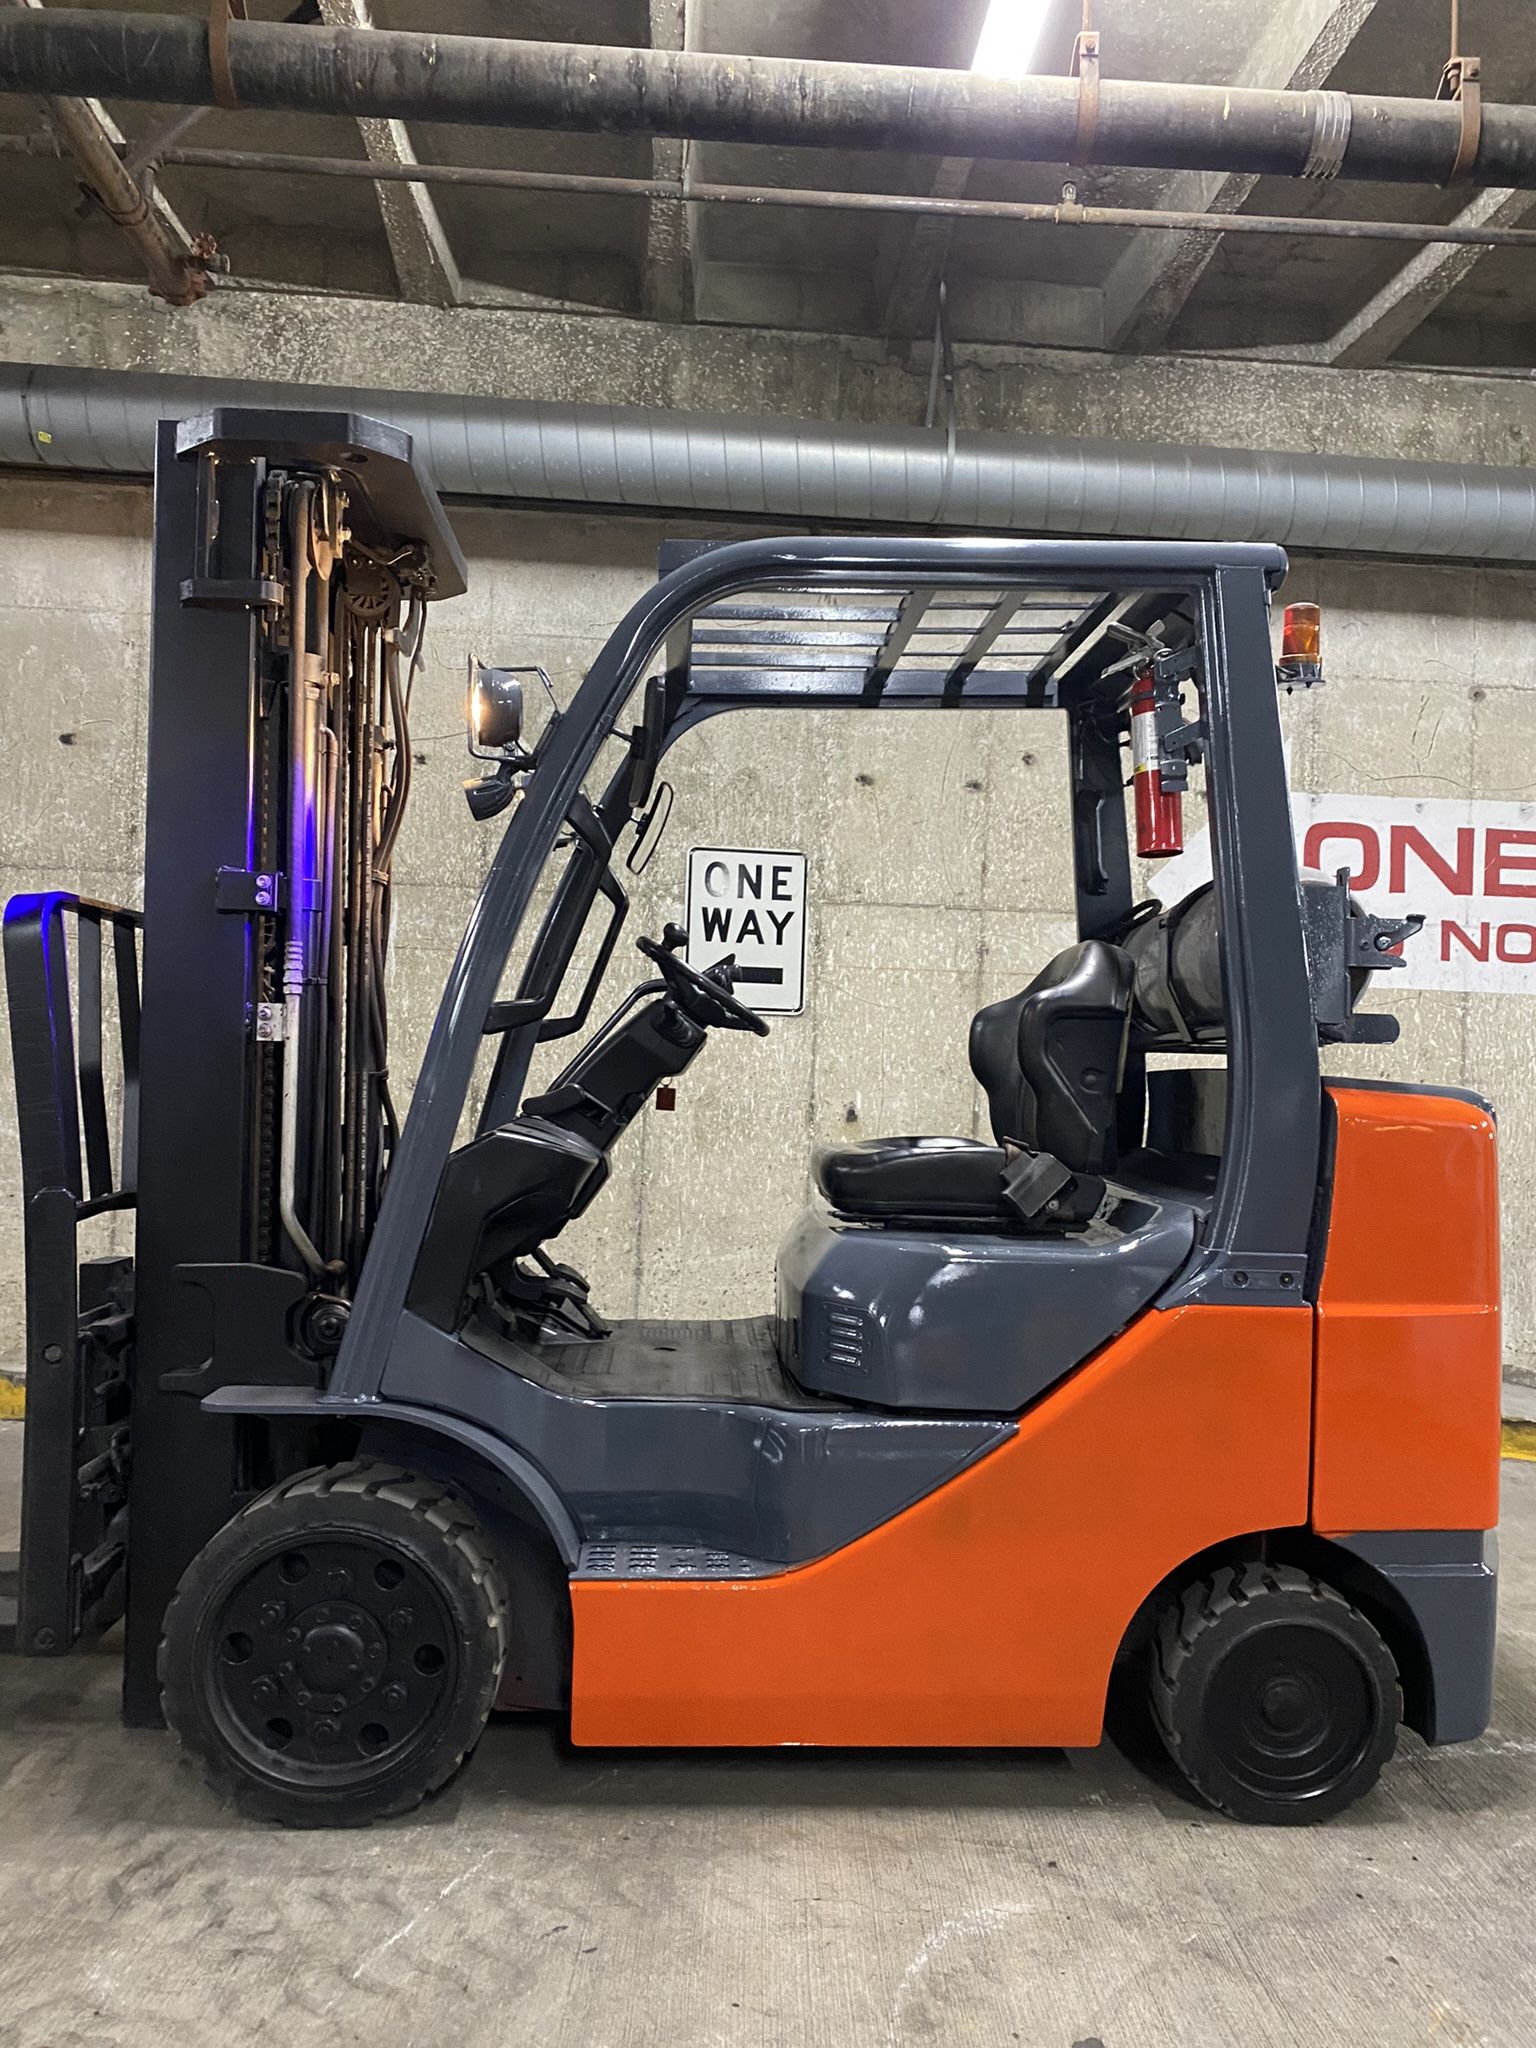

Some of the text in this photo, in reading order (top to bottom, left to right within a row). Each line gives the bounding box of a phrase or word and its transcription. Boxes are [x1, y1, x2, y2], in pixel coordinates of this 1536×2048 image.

[1303, 821, 1536, 898] ONE
[704, 861, 792, 901] ONE
[701, 906, 795, 946] WAY
